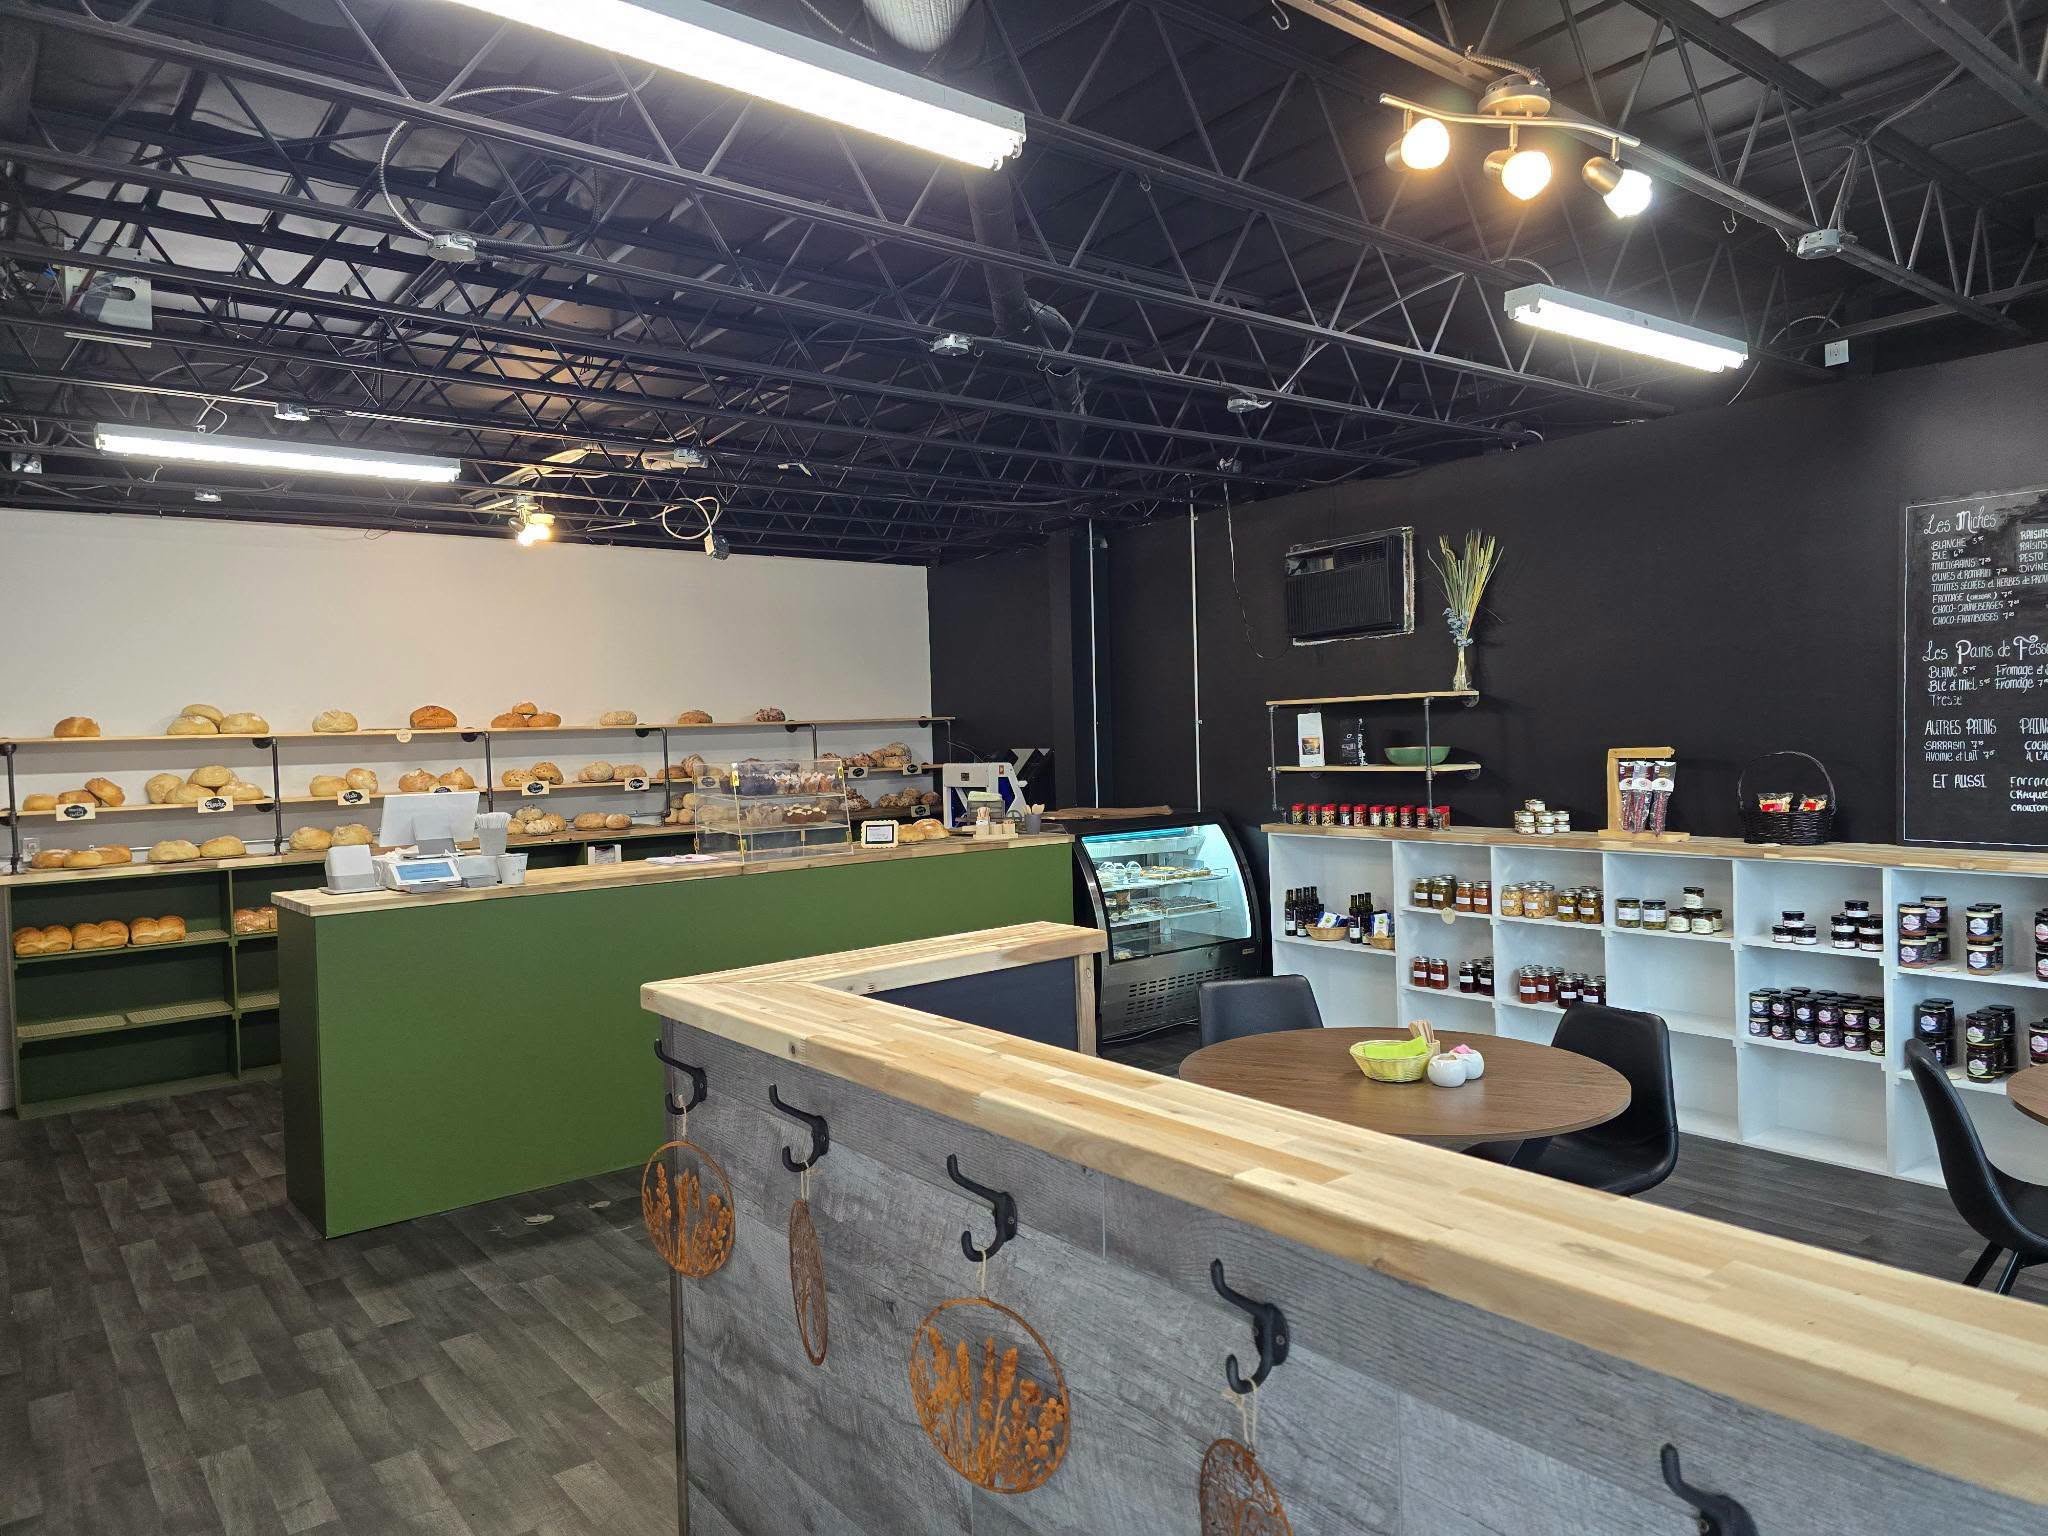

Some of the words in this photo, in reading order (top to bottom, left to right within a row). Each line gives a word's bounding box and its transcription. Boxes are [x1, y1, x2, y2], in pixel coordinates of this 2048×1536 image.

[1924, 514, 1951, 534] Les
[1931, 538, 1967, 551] BLANCHE
[2019, 552, 2044, 563] PESTO
[1922, 640, 1948, 661] Les
[1955, 640, 1993, 664] Pains
[1998, 640, 2010, 657] de
[2013, 635, 2048, 660] Fess
[1995, 664, 2034, 680] Fromage
[1994, 677, 2035, 693] Fromage
[1924, 720, 1961, 735] AUTRES
[1966, 718, 1997, 735] PAINS
[1932, 773, 1948, 789] ET
[1954, 773, 1987, 789] AUSSI
